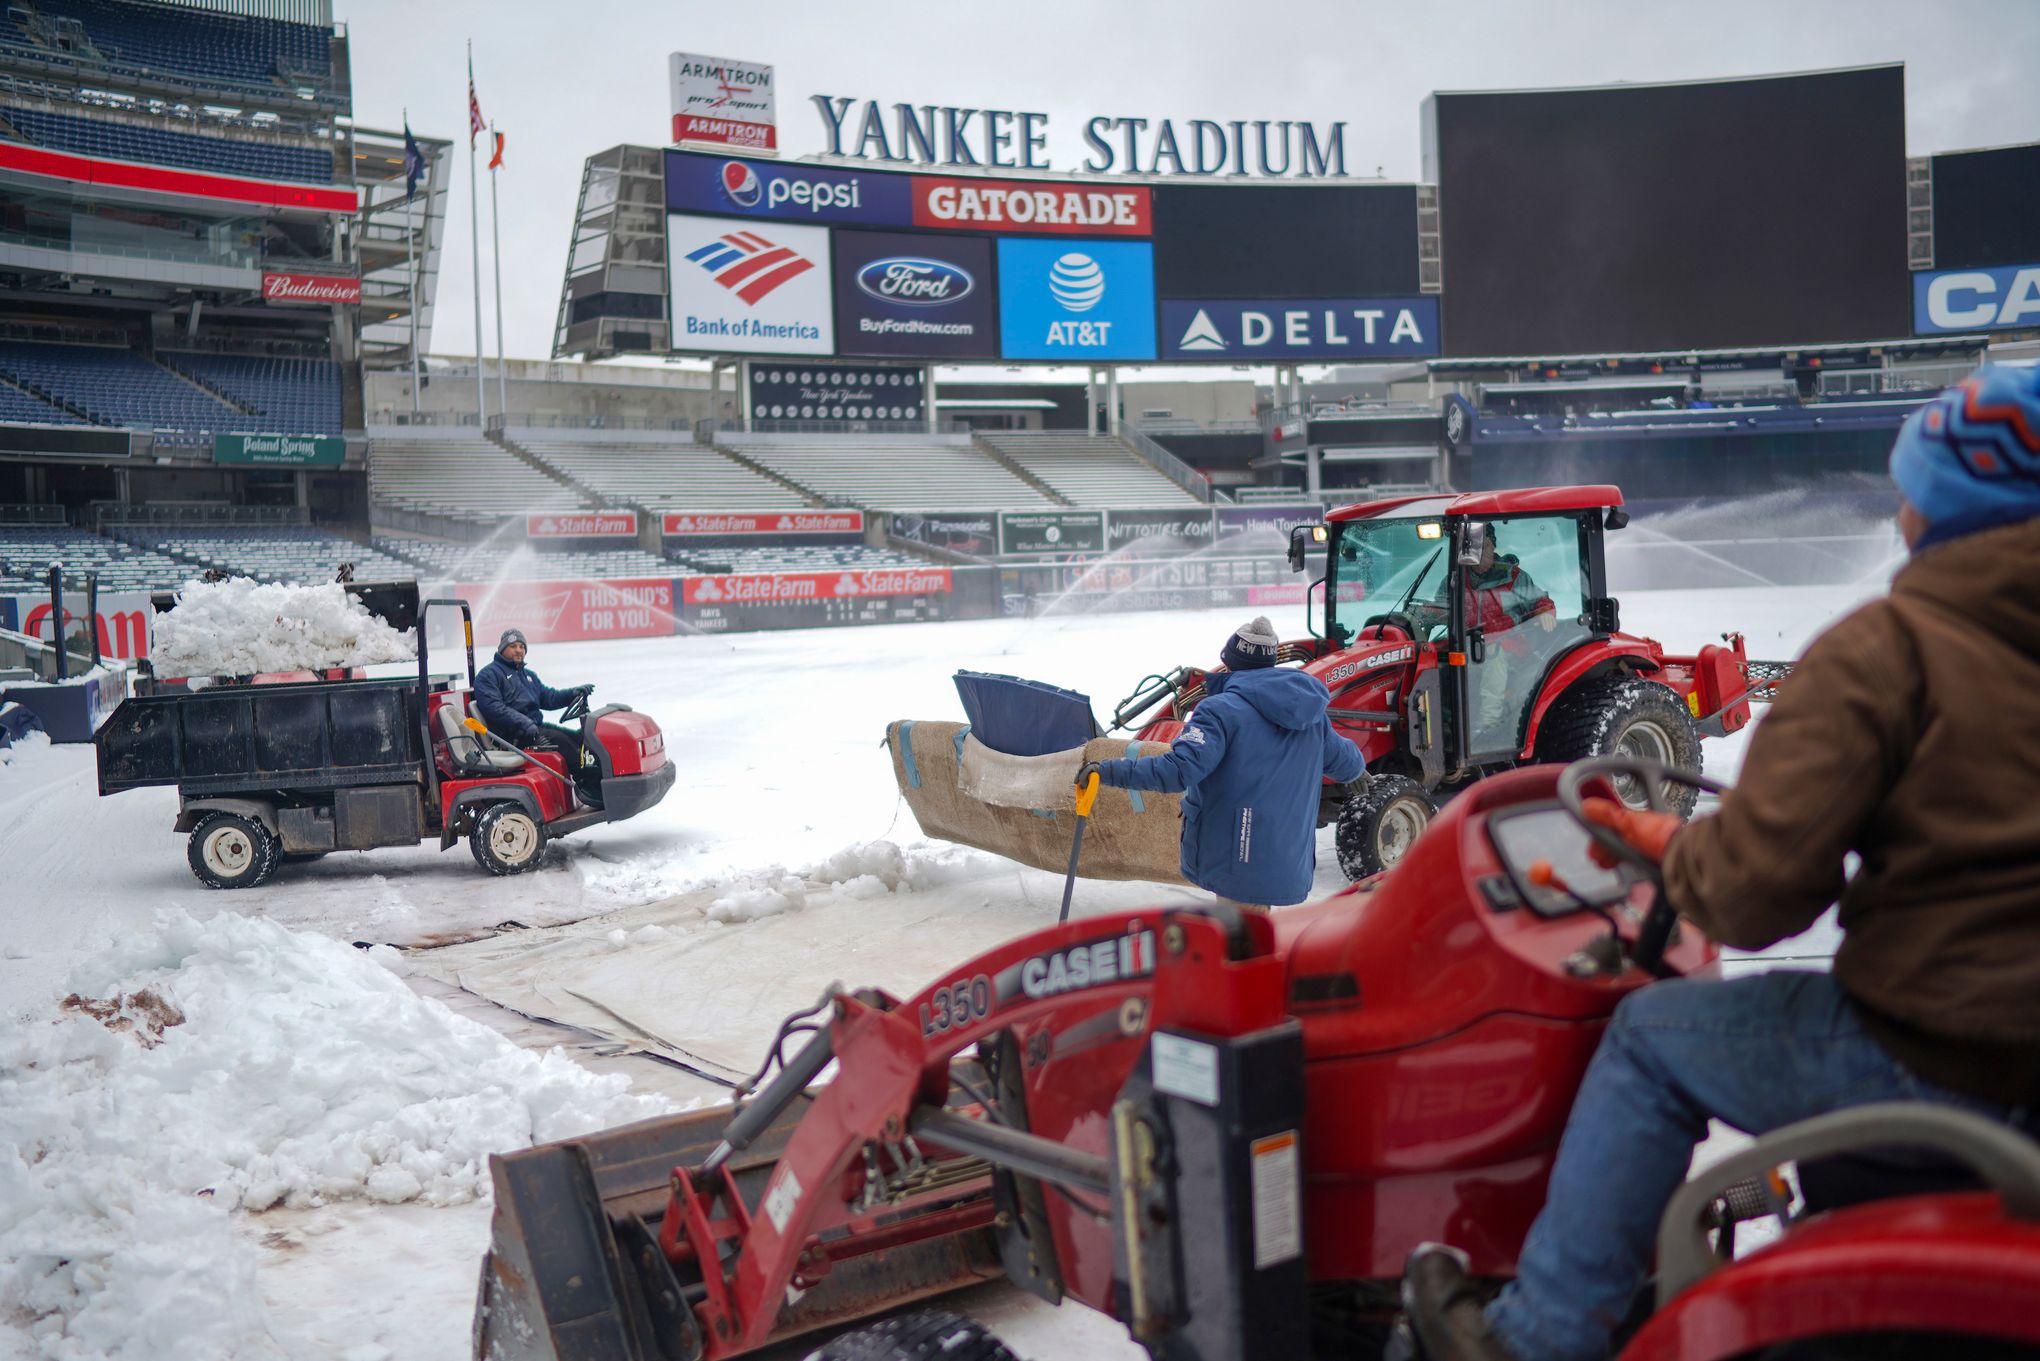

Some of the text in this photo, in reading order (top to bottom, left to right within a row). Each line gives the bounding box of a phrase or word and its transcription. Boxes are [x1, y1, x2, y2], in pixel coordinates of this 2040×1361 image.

[687, 118, 768, 139] ARMITRON
[808, 94, 1349, 177] YANKEE STADIUM
[768, 178, 860, 213] pepsi
[928, 186, 1137, 226] GATORADE
[264, 276, 360, 299] Budweiser
[879, 262, 951, 298] Ford
[686, 316, 819, 339] Bank of America
[860, 318, 973, 335] BuyFordNow.com
[1046, 321, 1112, 346] AT&T
[1241, 309, 1424, 346] DELTA
[243, 436, 316, 457] Poland Spring
[931, 520, 990, 532] Panasonic
[1109, 520, 1213, 538] NITTOTIRE.COM
[582, 586, 669, 608] THIS BUD'S
[582, 609, 655, 630] FOR YOU.
[1236, 639, 1256, 655] NEW
[1325, 663, 1356, 684] L350
[1366, 649, 1400, 668] CASE
[918, 973, 992, 1040] L350
[1021, 938, 1119, 999] CASE
